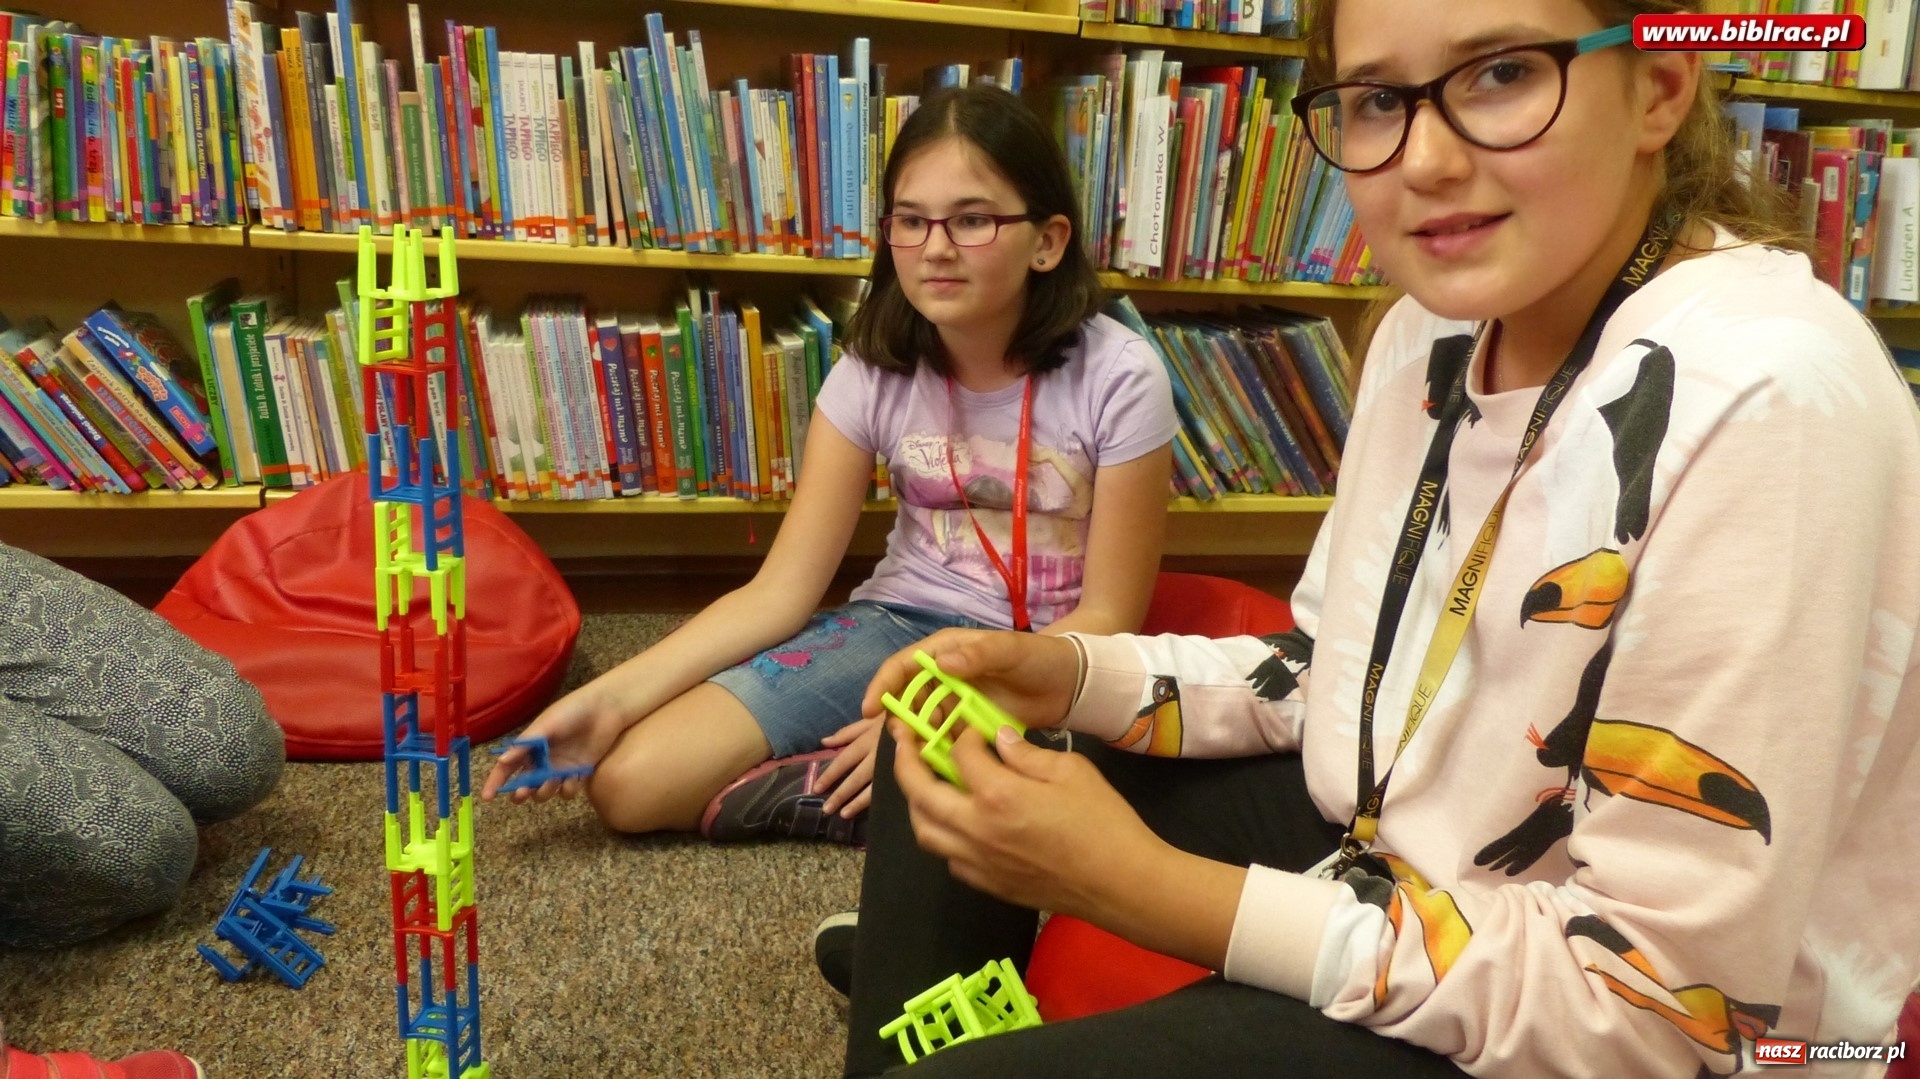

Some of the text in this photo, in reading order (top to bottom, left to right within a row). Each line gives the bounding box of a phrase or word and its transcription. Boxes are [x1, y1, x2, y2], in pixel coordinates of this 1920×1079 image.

[192, 93, 202, 130] OPOWIADA
[197, 140, 206, 179] PLANETACH
[503, 114, 518, 160] TAPPIEGO
[518, 115, 532, 161] TAPPIEGO
[533, 116, 547, 162] TAPPIEGO
[548, 117, 561, 163] TAPPIEGO
[1150, 152, 1164, 256] Chotomska
[1901, 222, 1914, 293] Lindgren
[245, 333, 262, 368] przyjaciele
[113, 385, 137, 409] Patryk
[134, 408, 144, 418] na
[142, 416, 171, 444] budowie
[205, 378, 219, 408] LICZBY
[615, 415, 629, 443] mamo
[635, 420, 648, 447] mamo
[654, 420, 668, 448] mamo
[676, 422, 690, 450] mamo
[910, 445, 962, 472] Violea
[1392, 480, 1438, 586] MAGNIFIQUE
[1450, 510, 1501, 617] MAGNIFIQU
[1360, 662, 1384, 770] MAGNIFIQUE
